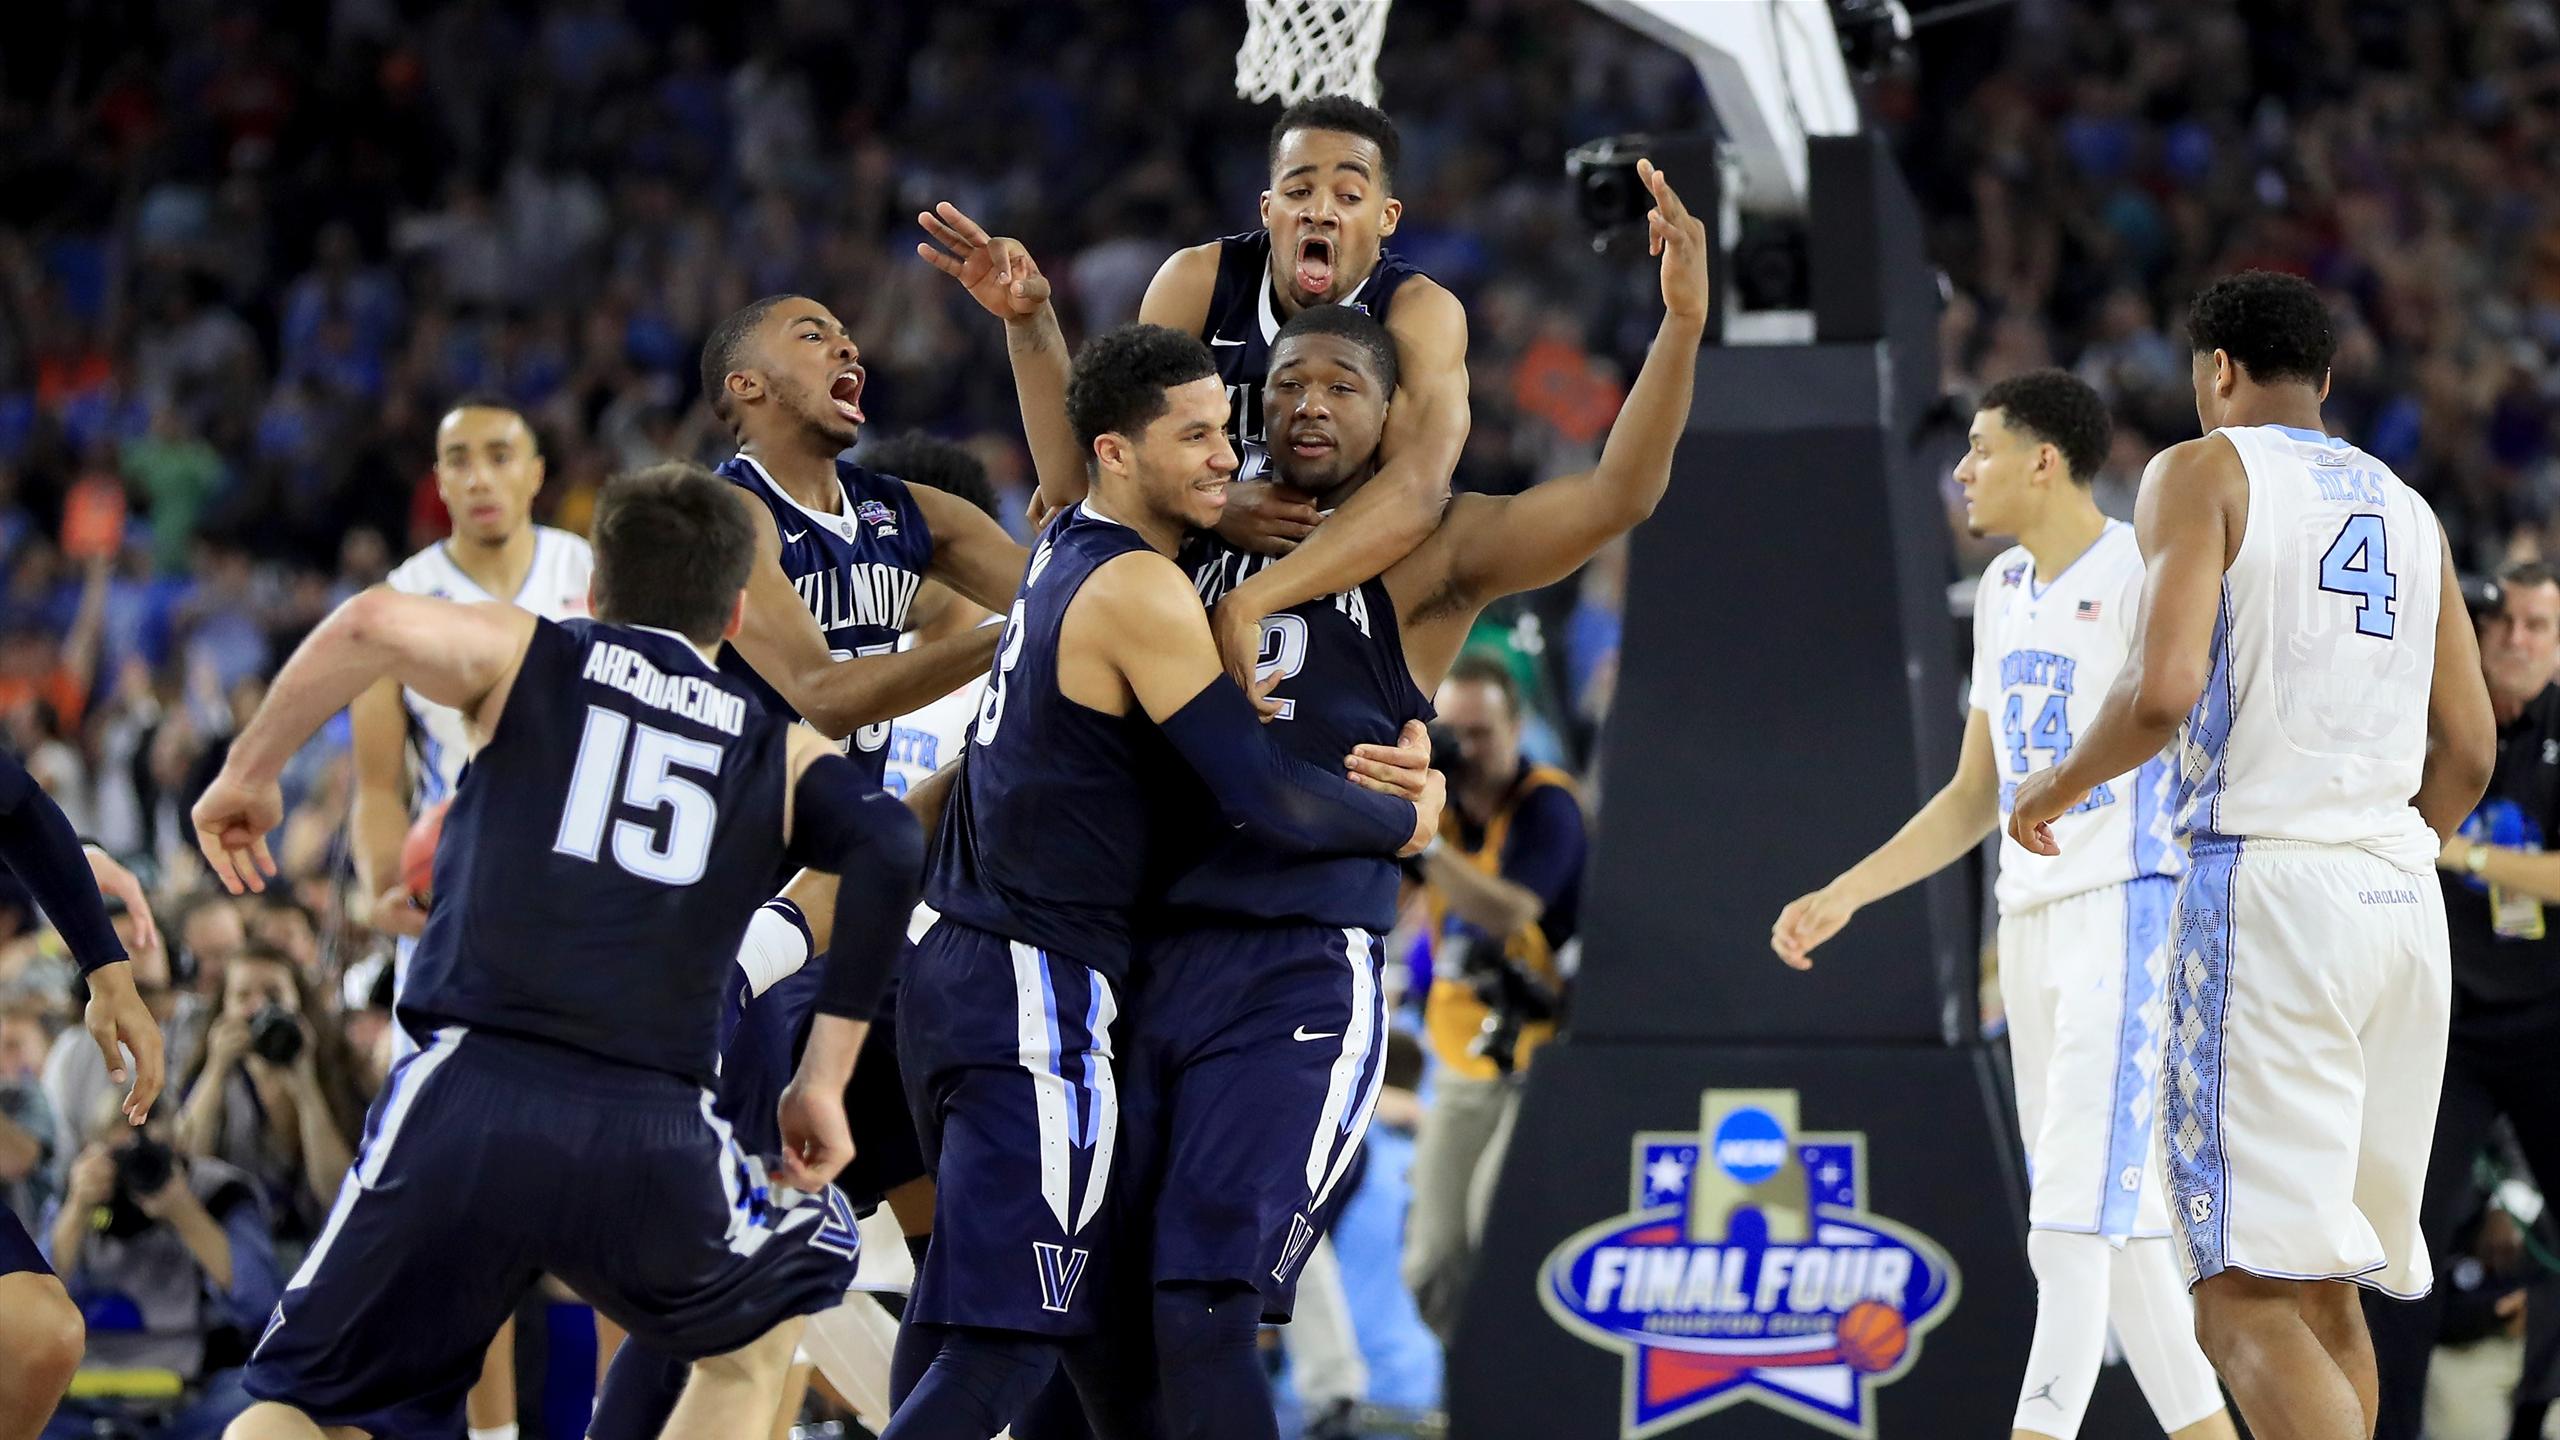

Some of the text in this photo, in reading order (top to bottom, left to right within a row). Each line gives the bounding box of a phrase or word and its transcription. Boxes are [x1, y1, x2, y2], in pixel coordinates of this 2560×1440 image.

[2308, 467, 2385, 507] HICKS
[2318, 513, 2397, 640] 4
[582, 640, 747, 737] ARCIDIACONO
[2003, 694, 2073, 773] 44
[551, 704, 725, 887] 15
[2358, 889, 2419, 905] CAROLINA
[1585, 1246, 1914, 1313] FINAL FOUR
